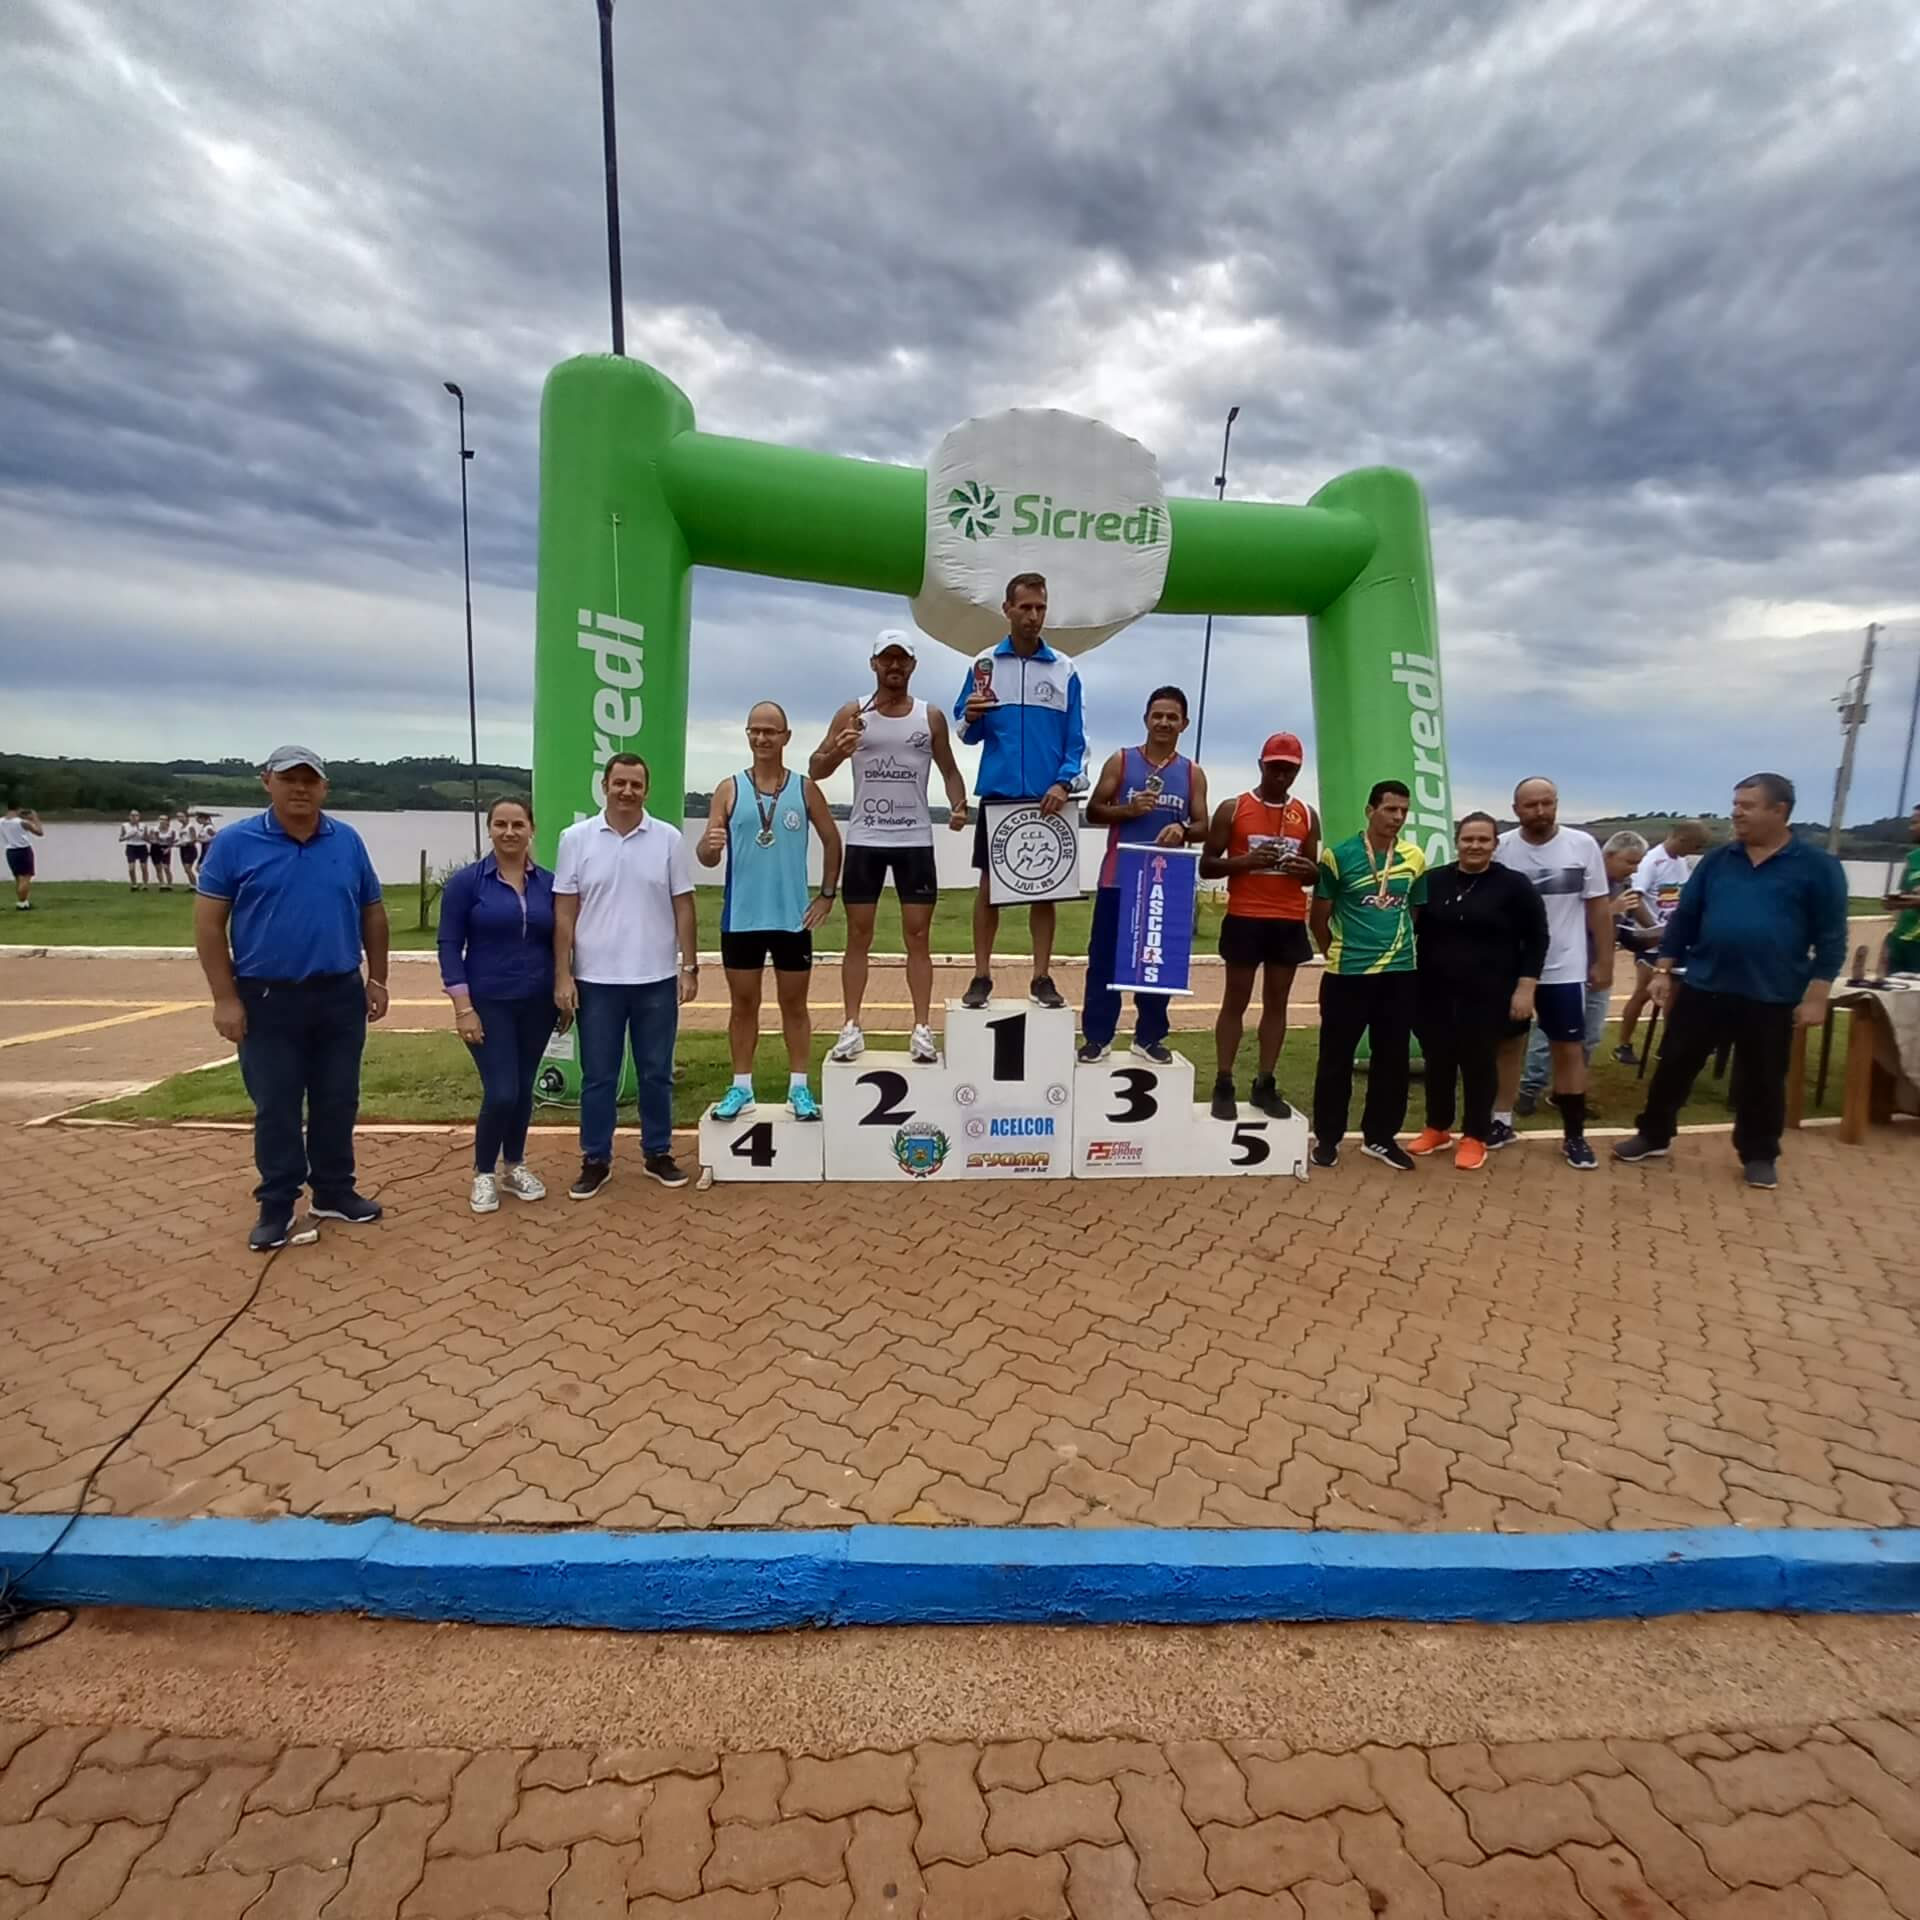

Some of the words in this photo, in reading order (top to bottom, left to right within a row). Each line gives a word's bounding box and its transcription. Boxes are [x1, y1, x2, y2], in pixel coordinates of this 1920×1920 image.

[1012, 494, 1160, 545] Sicredi
[877, 816, 917, 827] invisalign
[998, 823, 1013, 836] DE
[992, 837, 1006, 865] CLUBE
[1062, 849, 1073, 860] DE
[985, 1012, 1027, 1081] 1
[855, 1070, 917, 1126] 2
[1105, 1068, 1158, 1123] 3
[730, 1122, 777, 1167] 4
[990, 1117, 1055, 1136] ACELCOR
[1229, 1122, 1271, 1166] 5
